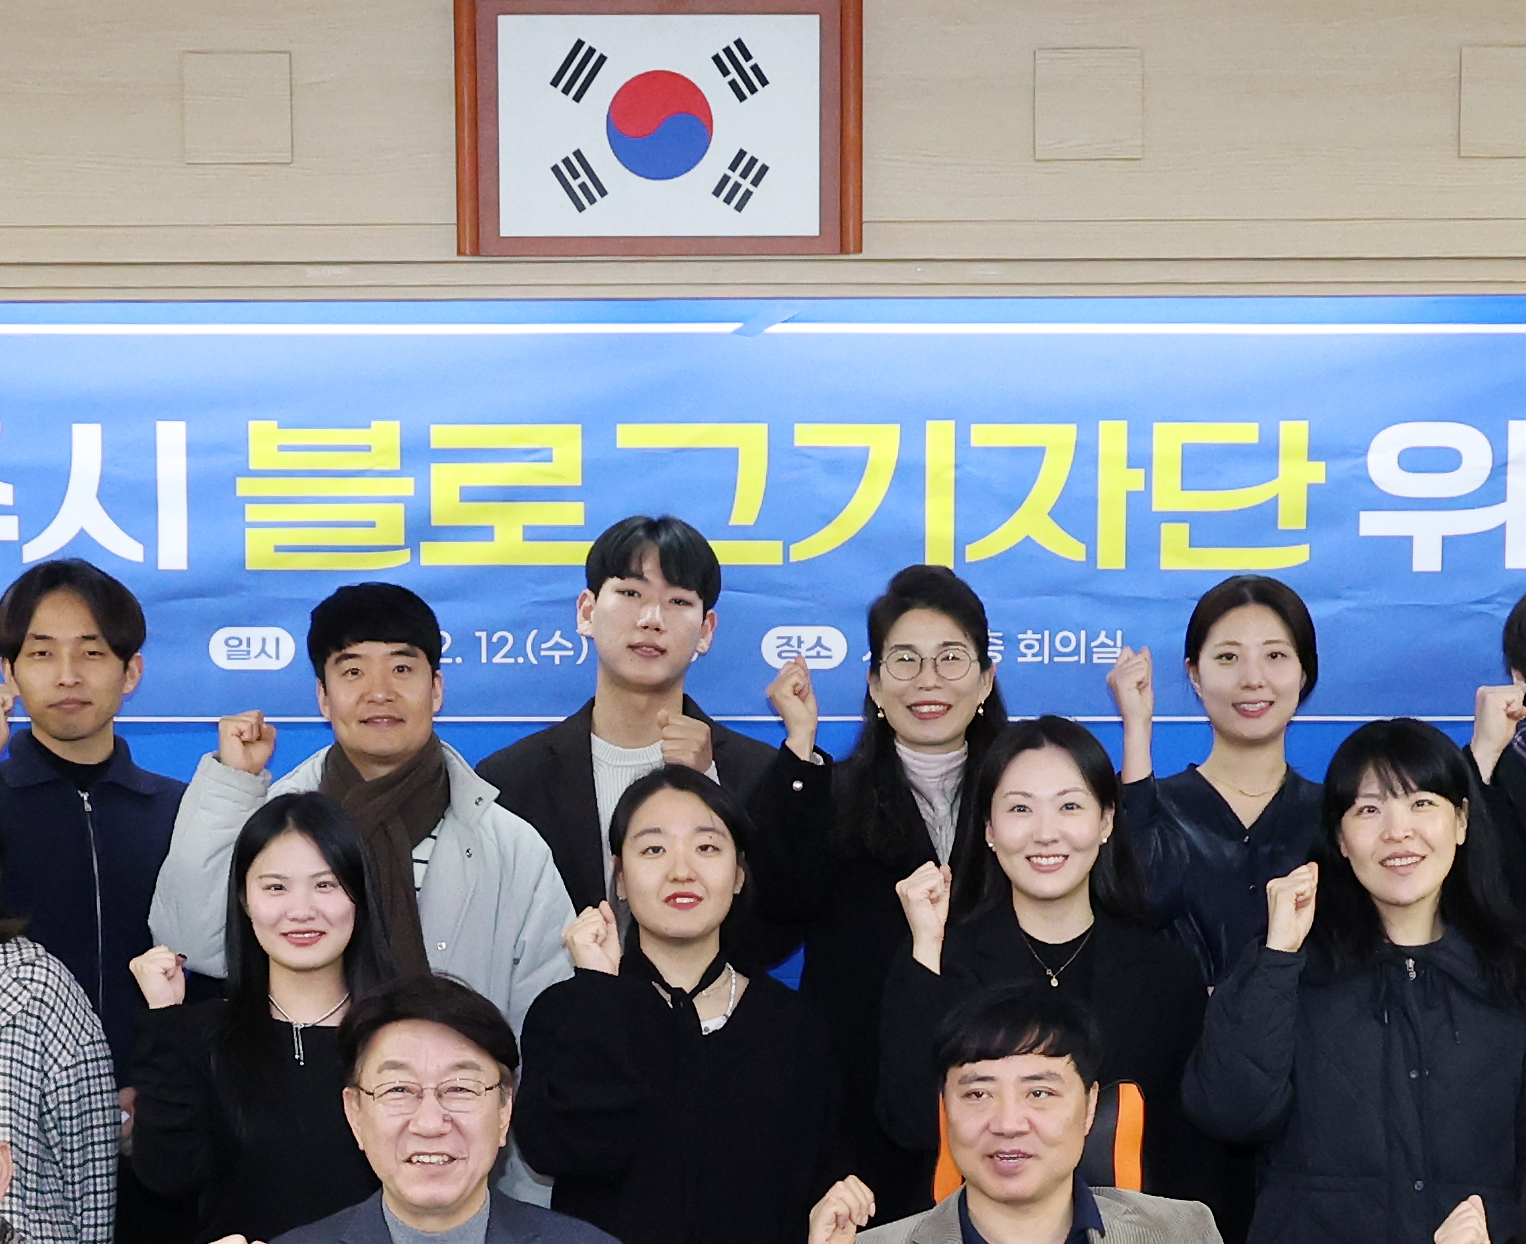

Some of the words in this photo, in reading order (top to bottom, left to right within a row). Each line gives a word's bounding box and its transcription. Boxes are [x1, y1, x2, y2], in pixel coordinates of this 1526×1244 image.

[224, 635, 281, 661] 일시
[474, 629, 589, 665] 12.(수)
[776, 635, 833, 660] 장소
[1017, 629, 1123, 664] 회의실
